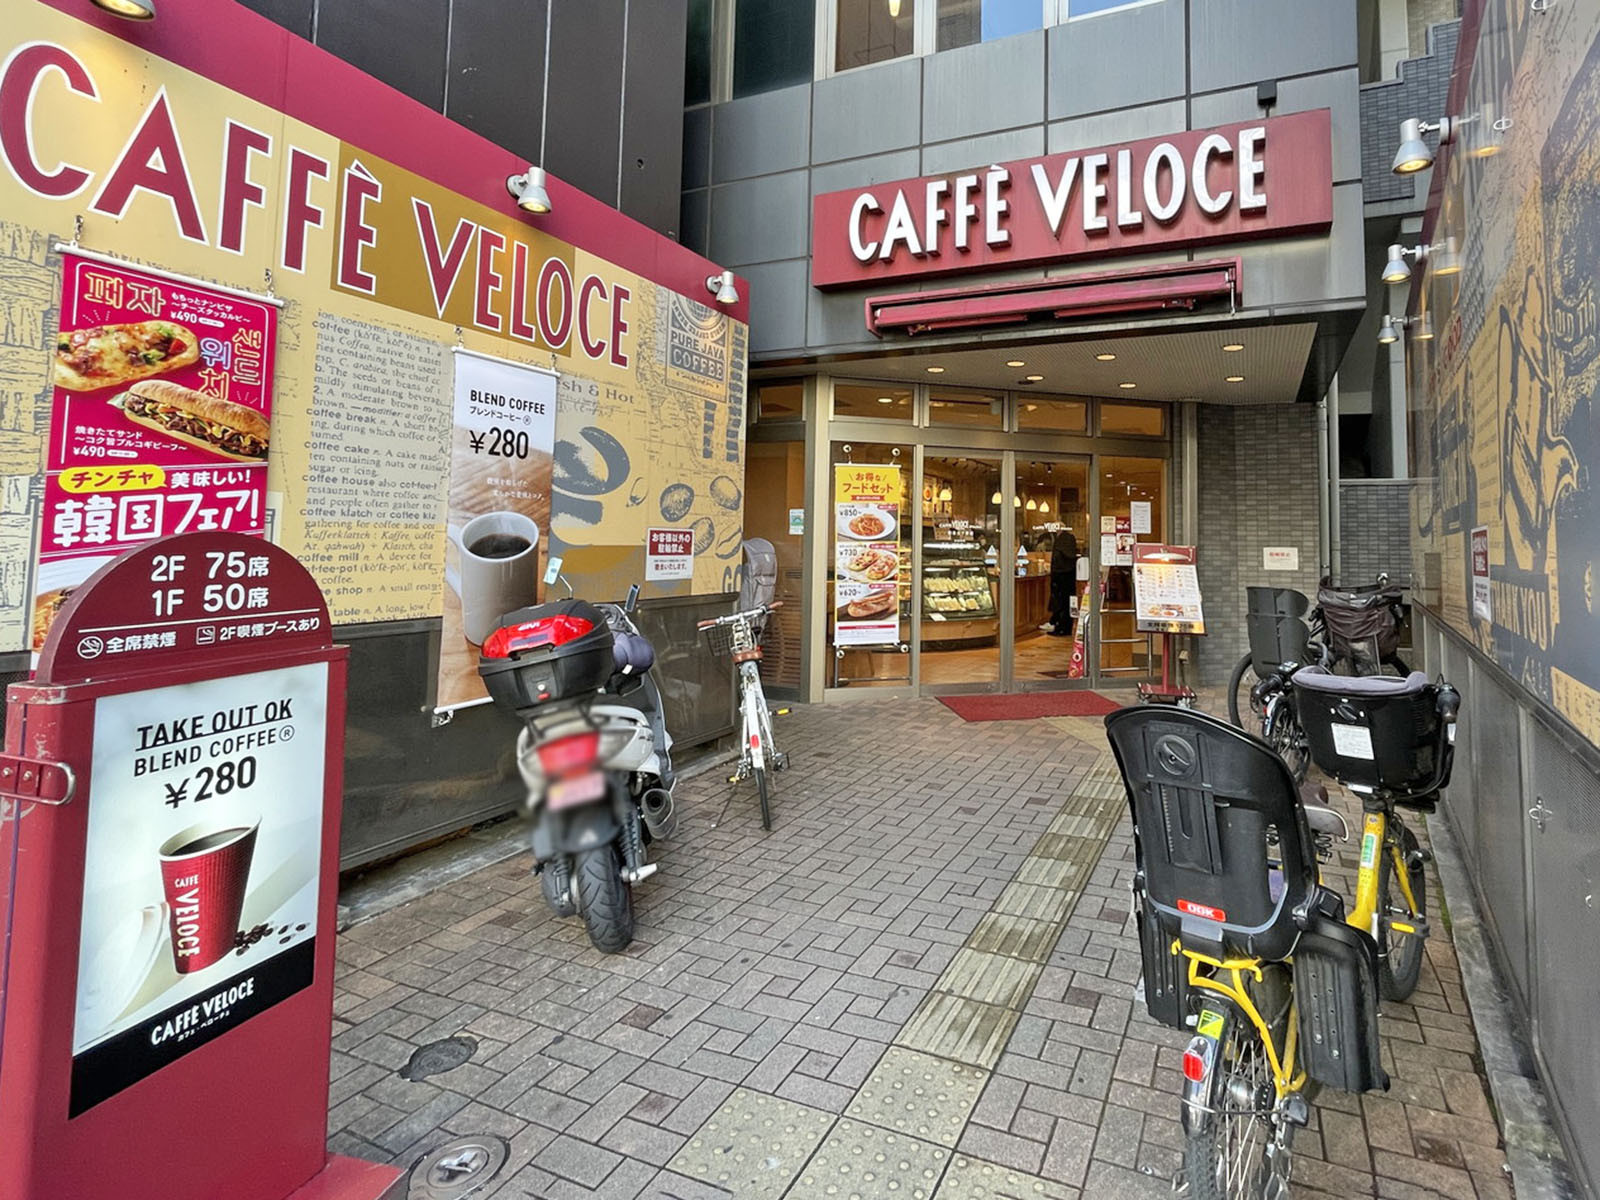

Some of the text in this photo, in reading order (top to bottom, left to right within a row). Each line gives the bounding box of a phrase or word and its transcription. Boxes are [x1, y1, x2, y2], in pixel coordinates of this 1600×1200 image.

[848, 126, 1268, 263] CAFFÈ VELOCE
[0, 40, 631, 370] CAFFÈ VELOCE
[84, 272, 166, 317] 피자
[170, 311, 198, 324] ¥490
[671, 330, 726, 361] PURE JAVA
[329, 365, 348, 377] The
[673, 349, 724, 380] COFFEE
[326, 388, 335, 396] A
[605, 388, 634, 404] Hot
[470, 390, 545, 415] BLEND COFFEE
[306, 408, 341, 419] coffee
[346, 412, 376, 424] break
[333, 421, 366, 435] during
[369, 427, 396, 438] which
[73, 445, 105, 457] ¥490
[304, 441, 340, 452] coffee
[344, 445, 370, 454] cake
[469, 426, 529, 459] ¥280
[330, 455, 381, 468] containing
[385, 460, 404, 468] nuts
[71, 469, 154, 488] チンチャ
[302, 474, 338, 484] coffee
[342, 476, 375, 486] house
[307, 486, 358, 496] restaurant
[362, 488, 390, 497] where
[842, 483, 893, 493] フードセット
[306, 497, 325, 505] and
[330, 498, 363, 509] people
[365, 499, 389, 508] often
[299, 508, 336, 516] coffee
[341, 509, 373, 518] klatch
[390, 512, 420, 520] coffee
[305, 518, 352, 531] gathering
[356, 520, 370, 528] for
[373, 520, 401, 529] coffee
[296, 553, 333, 561] coffee
[339, 552, 359, 561] mill
[151, 551, 270, 582] 2F 75席
[336, 586, 363, 596] shop
[151, 584, 270, 617] 1F 50席
[334, 608, 360, 616] table
[1520, 587, 1548, 651] YOU
[106, 630, 177, 654] 全席禁煙
[136, 698, 293, 751] TAKE OUT OK
[134, 746, 201, 777] BLEND
[164, 755, 257, 808] ¥280
[175, 888, 200, 957] VELOCE
[202, 977, 254, 1017] VELOCE
